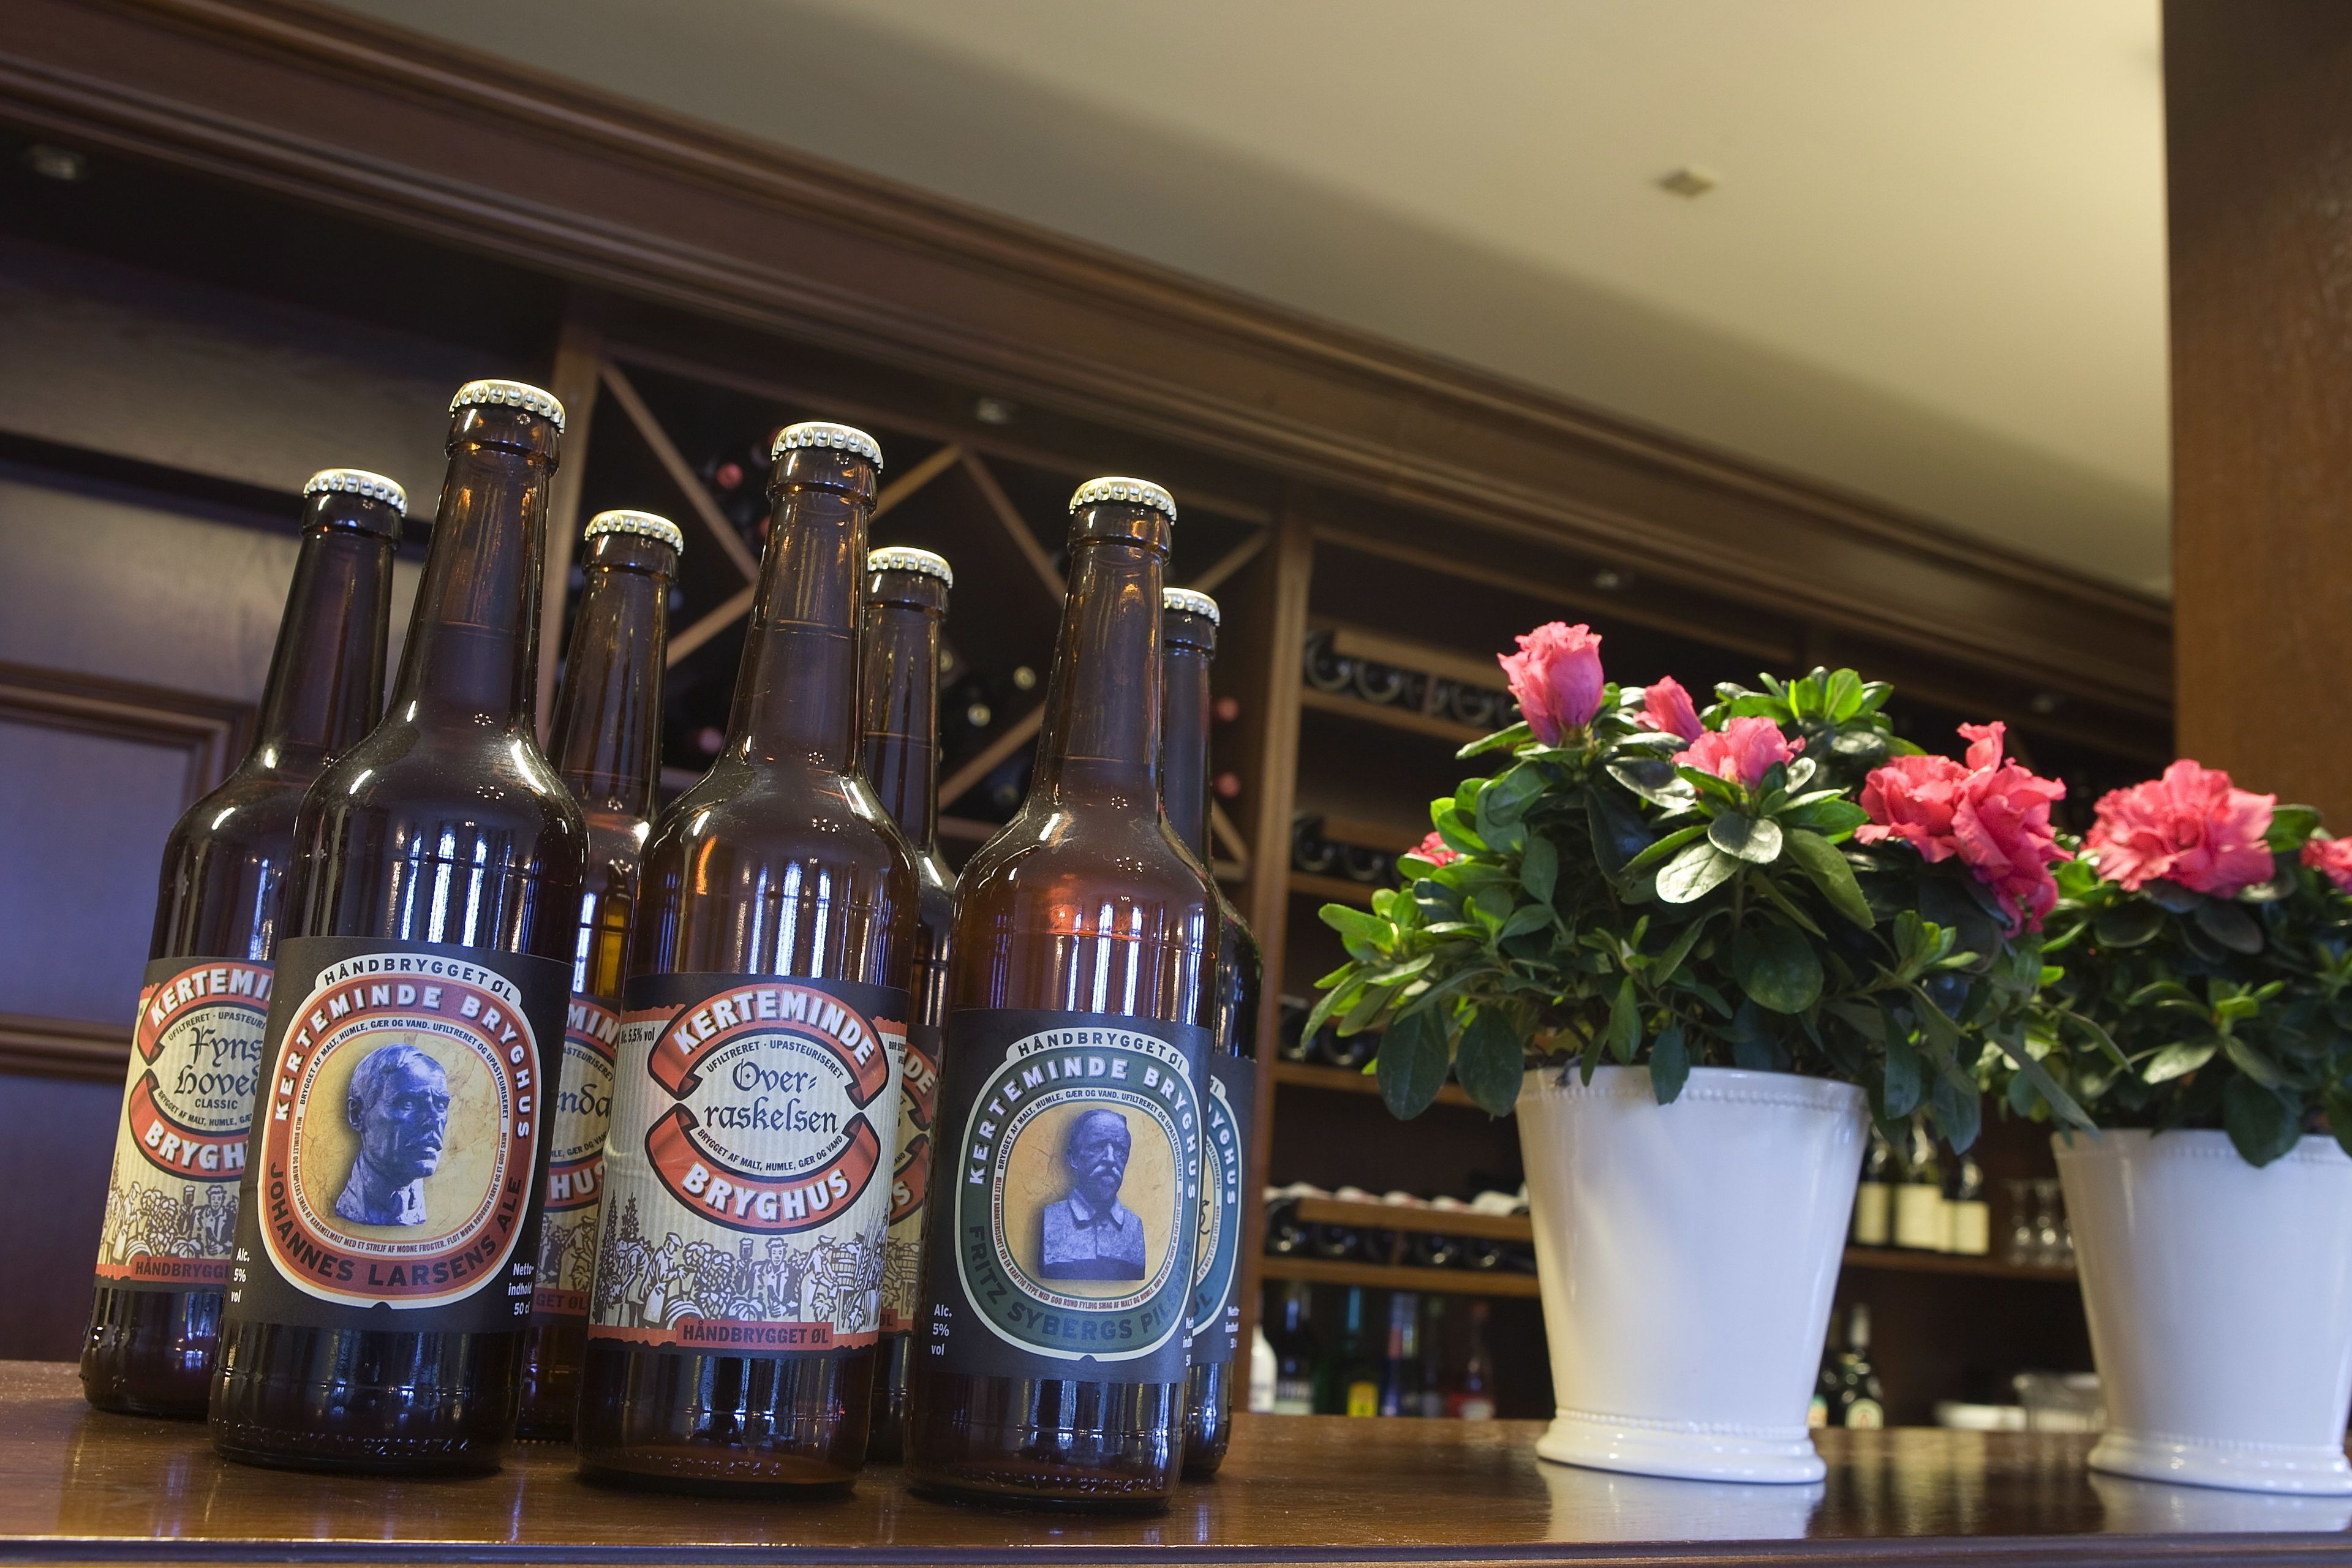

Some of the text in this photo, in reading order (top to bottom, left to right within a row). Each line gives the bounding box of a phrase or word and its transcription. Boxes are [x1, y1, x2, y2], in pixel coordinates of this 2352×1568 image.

[325, 958, 511, 1002] HÅNDBRYGGET ØL
[150, 968, 270, 1027] KERTEMI
[168, 1012, 266, 1041] UFILTRERET UPASTEURI
[644, 1027, 655, 1041] vol
[673, 989, 875, 1067] KERTEMINDE
[189, 1025, 263, 1067] Fyns
[1017, 1032, 1166, 1057] HÅNDBRYGGET
[275, 983, 531, 1140] KERTEMINDE BRYGHUS
[706, 1039, 844, 1079] UFILTRERET UPASTEURISERET
[300, 1068, 316, 1105] BRYGGET
[314, 1055, 322, 1068] AF
[321, 1038, 339, 1057] MALT,
[339, 1023, 369, 1040] HUMLE,
[371, 1019, 390, 1028] GÆR
[432, 1022, 478, 1046] UFILTRERET
[477, 1043, 488, 1055] OG
[486, 1052, 509, 1120] UPASTEURISERET
[158, 1090, 179, 1117] BRYGGET
[178, 1110, 187, 1119] AF
[188, 1115, 206, 1126] MALT,
[209, 1117, 238, 1126] HUMLE,
[195, 1098, 238, 1110] CLASSIC
[704, 1096, 839, 1134] raskelsen
[969, 1057, 1197, 1199] KERTEMINDE BRYGHUS
[567, 1146, 583, 1156] GÆR
[584, 1141, 594, 1150] OG
[594, 1131, 607, 1145] VAN
[998, 1135, 1013, 1170] BRYGGET
[1010, 1123, 1019, 1135] AF
[1017, 1107, 1036, 1125] MALT,
[1035, 1093, 1063, 1109] HUMLE,
[1098, 1090, 1119, 1099] VAND.
[1121, 1093, 1159, 1114] UFILTRERET
[1157, 1111, 1167, 1122] OG
[1165, 1120, 1183, 1182] UPASTEURISERET
[144, 1119, 246, 1170] BRYGH
[697, 1129, 843, 1171] BRYGGET AF MALT, HUMLE, GÆR OG VAND
[494, 1172, 502, 1183] OG
[497, 1166, 503, 1174] ET
[292, 1164, 303, 1197] KOMPLEKS
[488, 1182, 499, 1202] FARVE
[682, 1161, 850, 1221] BRYGHUS
[297, 1196, 309, 1214] SMAG
[473, 1200, 493, 1225] RØDBRUN
[304, 1211, 312, 1221] AF
[270, 1162, 356, 1281] JOHANNES
[368, 1234, 497, 1287] LARSENS
[497, 1177, 522, 1234] ALE
[309, 1217, 344, 1243] KARAMELMALT
[460, 1223, 475, 1238] MØRK
[343, 1238, 357, 1250] MED
[447, 1232, 461, 1245] FLOT
[236, 1248, 250, 1262] Alc.
[366, 1244, 387, 1253] STREJF
[396, 1244, 418, 1253] MODNE
[999, 1248, 1008, 1261] VED
[1003, 1259, 1012, 1268] EN
[233, 1268, 247, 1283] 5%
[969, 1226, 1008, 1305] FRITZ
[1006, 1301, 1133, 1340] SYBERGS
[1008, 1265, 1027, 1287] KRAFTIG
[231, 1289, 242, 1303] vol
[508, 1282, 532, 1295] indhold
[1025, 1283, 1039, 1296] TYPE
[1038, 1291, 1050, 1301] MED
[1050, 1296, 1063, 1305] GOD
[1063, 1298, 1078, 1308] RUND
[1079, 1300, 1098, 1310] FYLDIG
[1098, 1300, 1113, 1310] SMAG
[1114, 1300, 1120, 1308] AF
[1120, 1298, 1133, 1308] MALT
[513, 1302, 524, 1316] 50
[934, 1303, 952, 1317] Alc.
[683, 1321, 829, 1344] HÅNDBRYGGET ØL
[932, 1322, 949, 1336] 5%
[931, 1343, 944, 1355] vol
